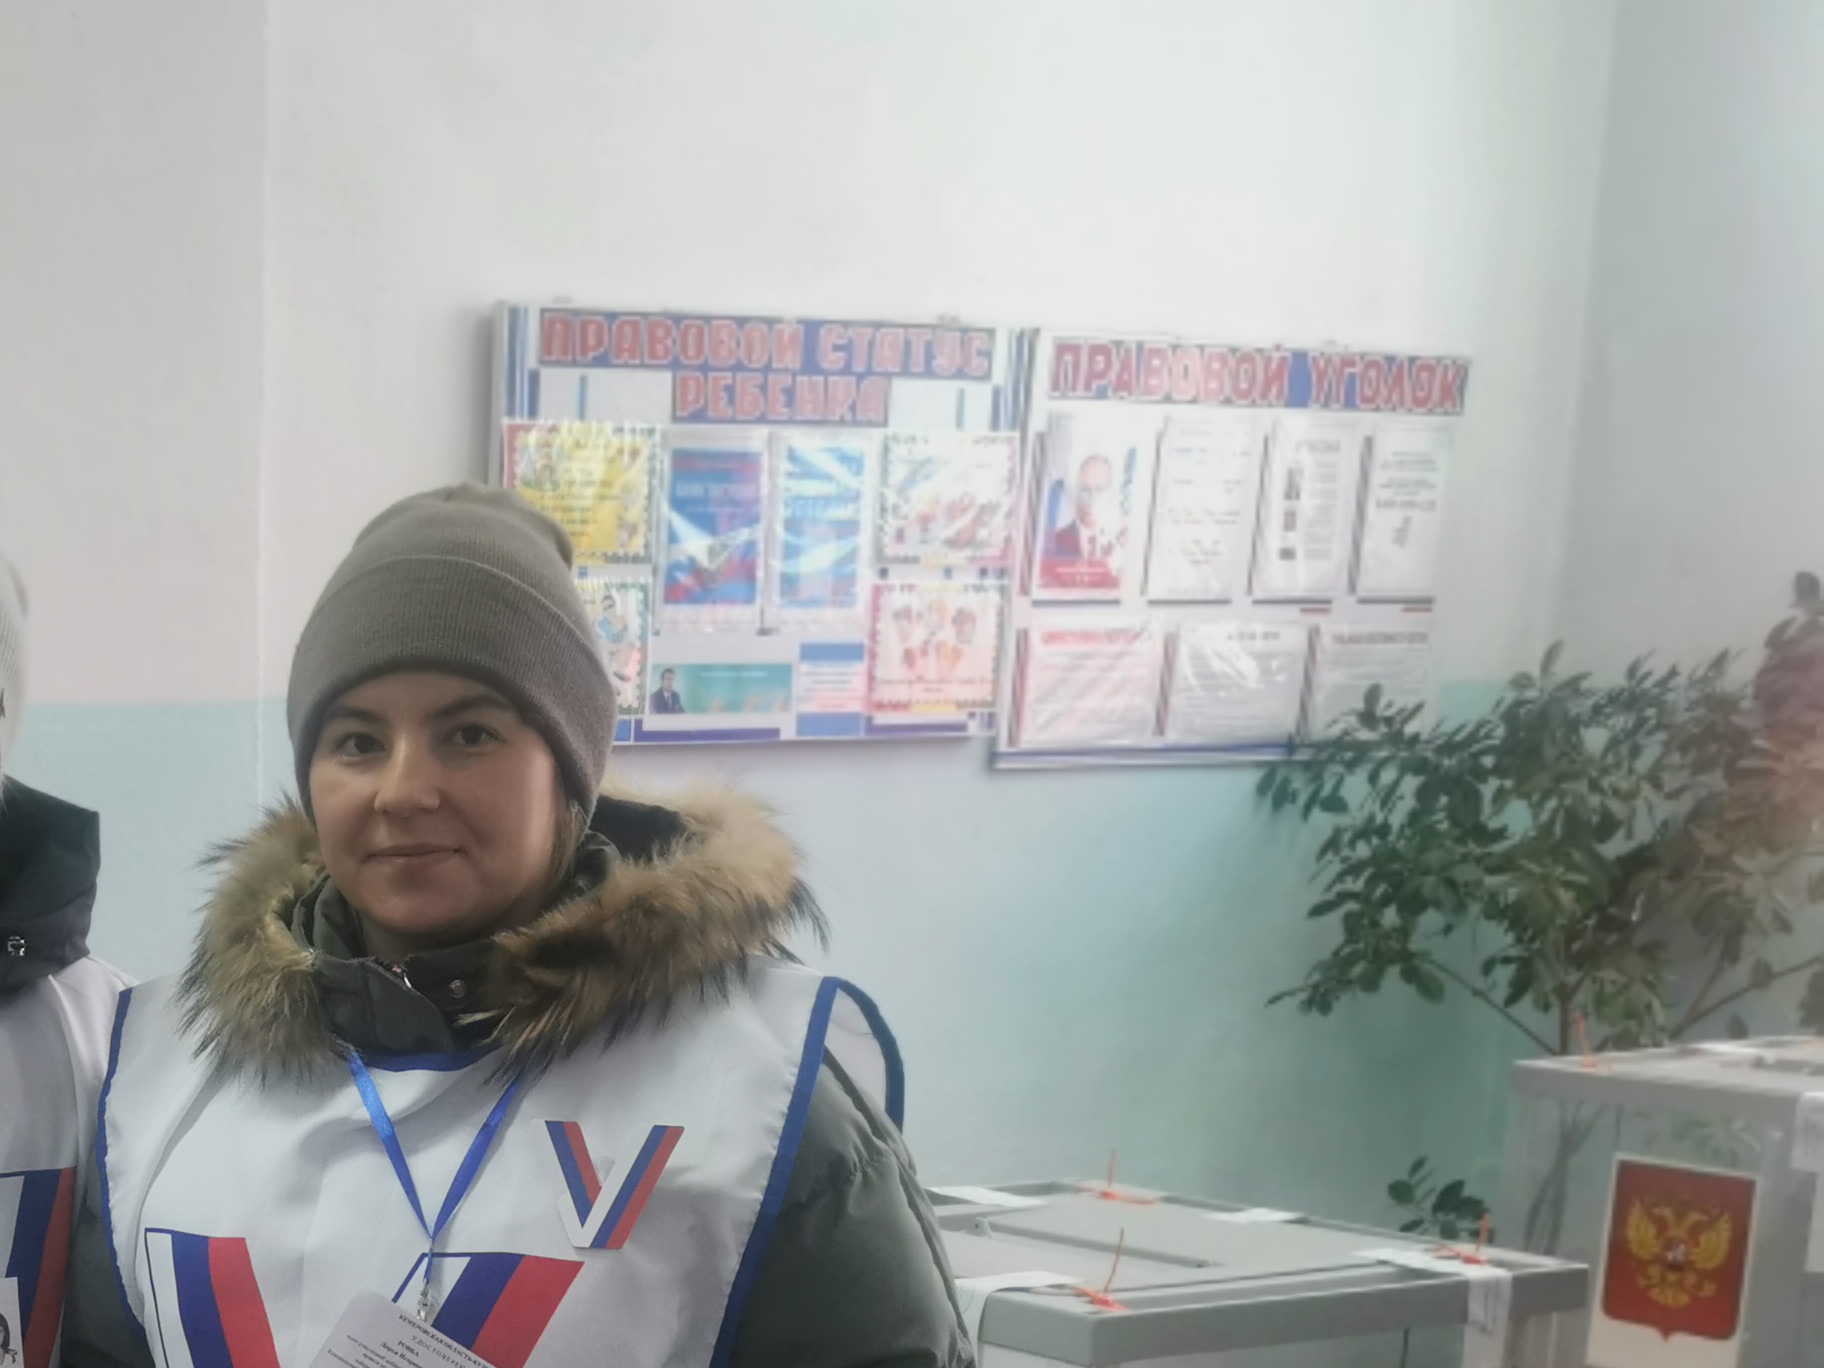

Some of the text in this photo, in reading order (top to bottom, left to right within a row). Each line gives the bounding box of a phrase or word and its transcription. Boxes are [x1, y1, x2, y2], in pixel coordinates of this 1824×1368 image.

[542, 312, 992, 377] ПРАВОВОЙ СТАТУС
[1051, 341, 1468, 412] ПРАВОВОЙ УГОЛОК
[676, 371, 889, 422] РЕБЕНКА
